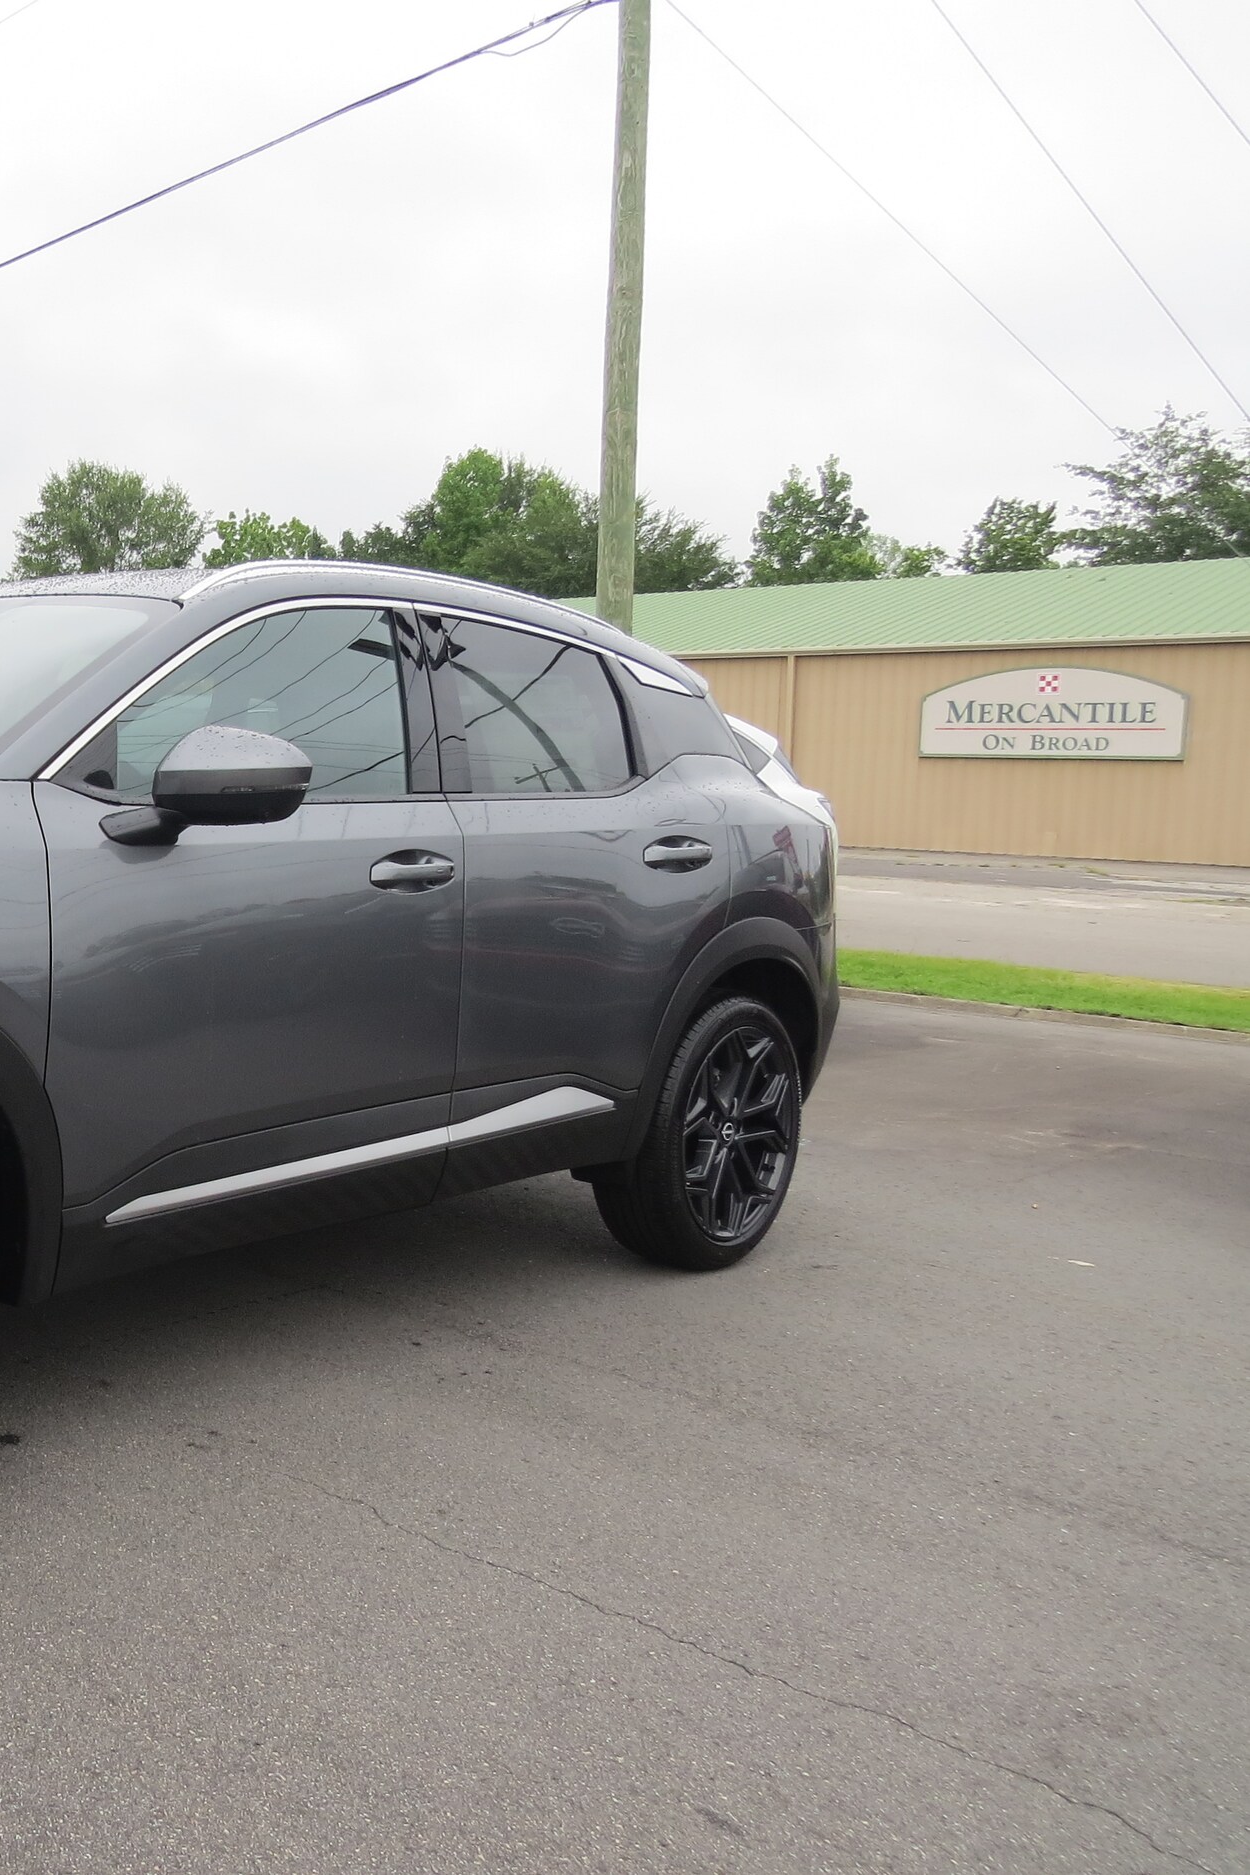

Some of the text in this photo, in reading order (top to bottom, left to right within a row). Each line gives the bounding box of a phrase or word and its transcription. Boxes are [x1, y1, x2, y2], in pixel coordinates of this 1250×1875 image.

[945, 700, 1157, 724] MERCANTILE
[982, 733, 1110, 751] ON BROAD
